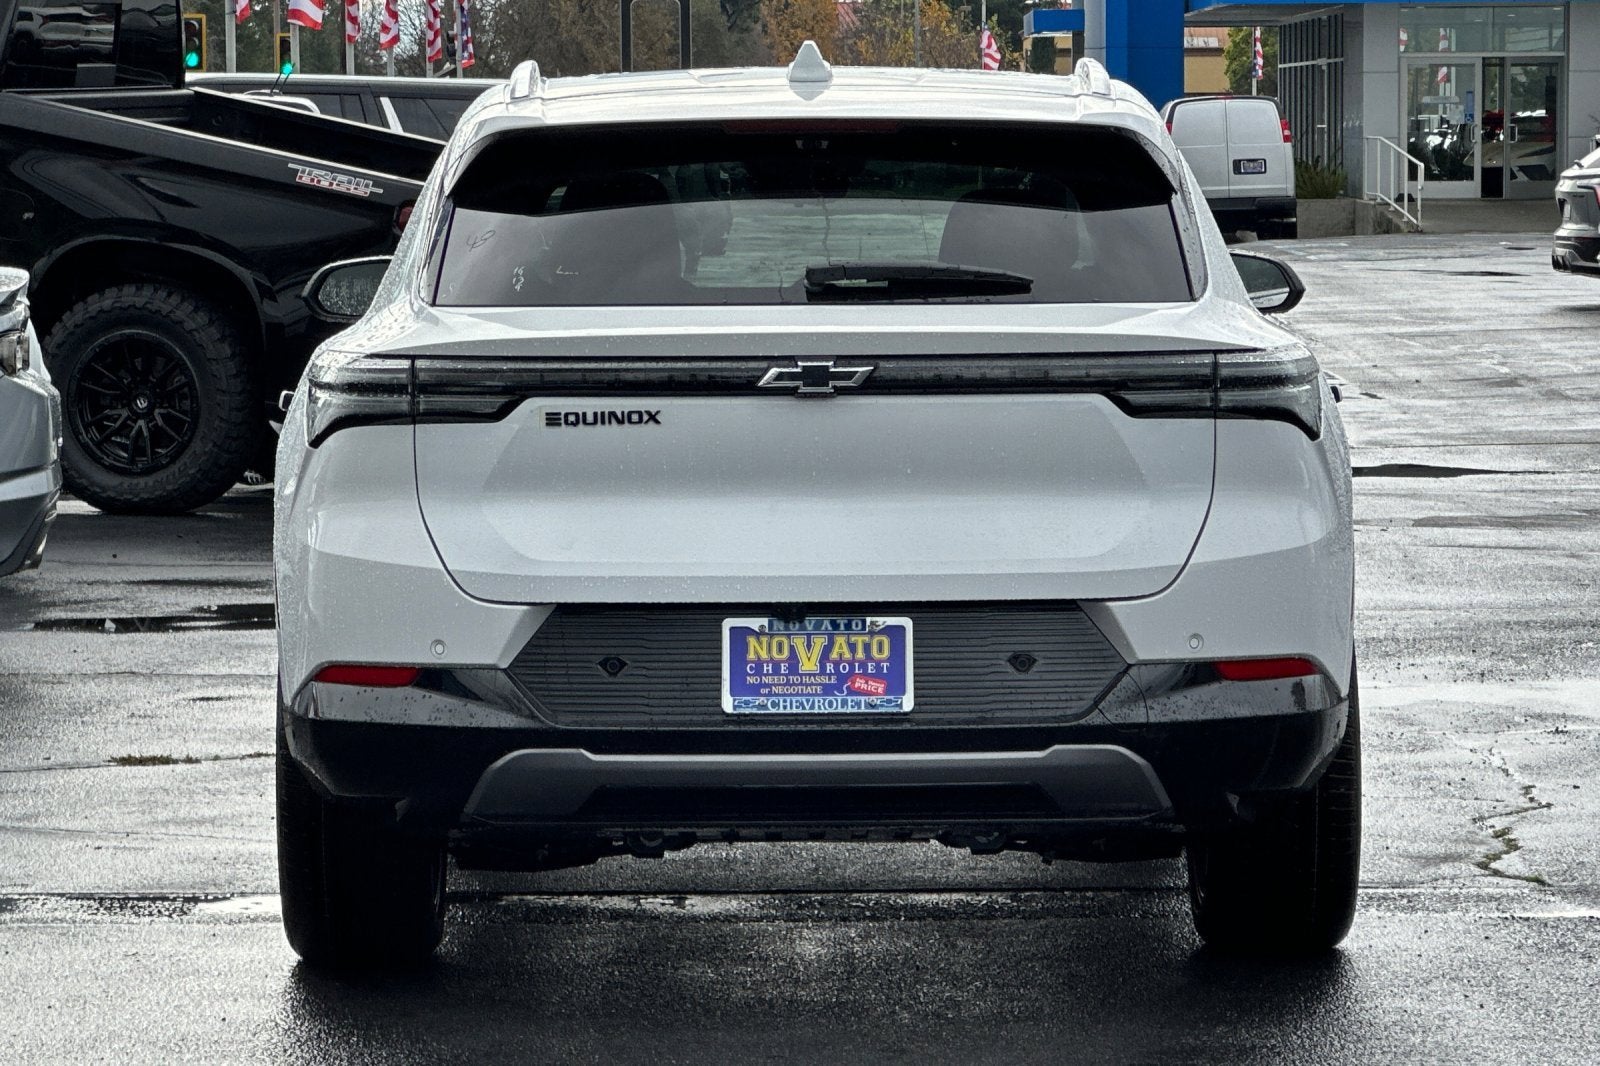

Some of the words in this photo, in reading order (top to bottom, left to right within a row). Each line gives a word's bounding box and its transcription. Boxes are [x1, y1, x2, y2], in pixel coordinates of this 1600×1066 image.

[288, 163, 384, 194] TRAIL
[296, 173, 371, 197] BOSS
[545, 410, 661, 427] EQUINOX
[773, 619, 863, 631] NOVATO
[746, 634, 891, 673] NOVATO
[746, 676, 760, 684] NO
[761, 676, 787, 684] NEED
[789, 676, 801, 684] TO
[802, 676, 837, 684] HASSLE
[772, 685, 823, 694] NEGOTIATE
[855, 682, 885, 694] PRICE
[767, 698, 867, 711] CHEVROLET
